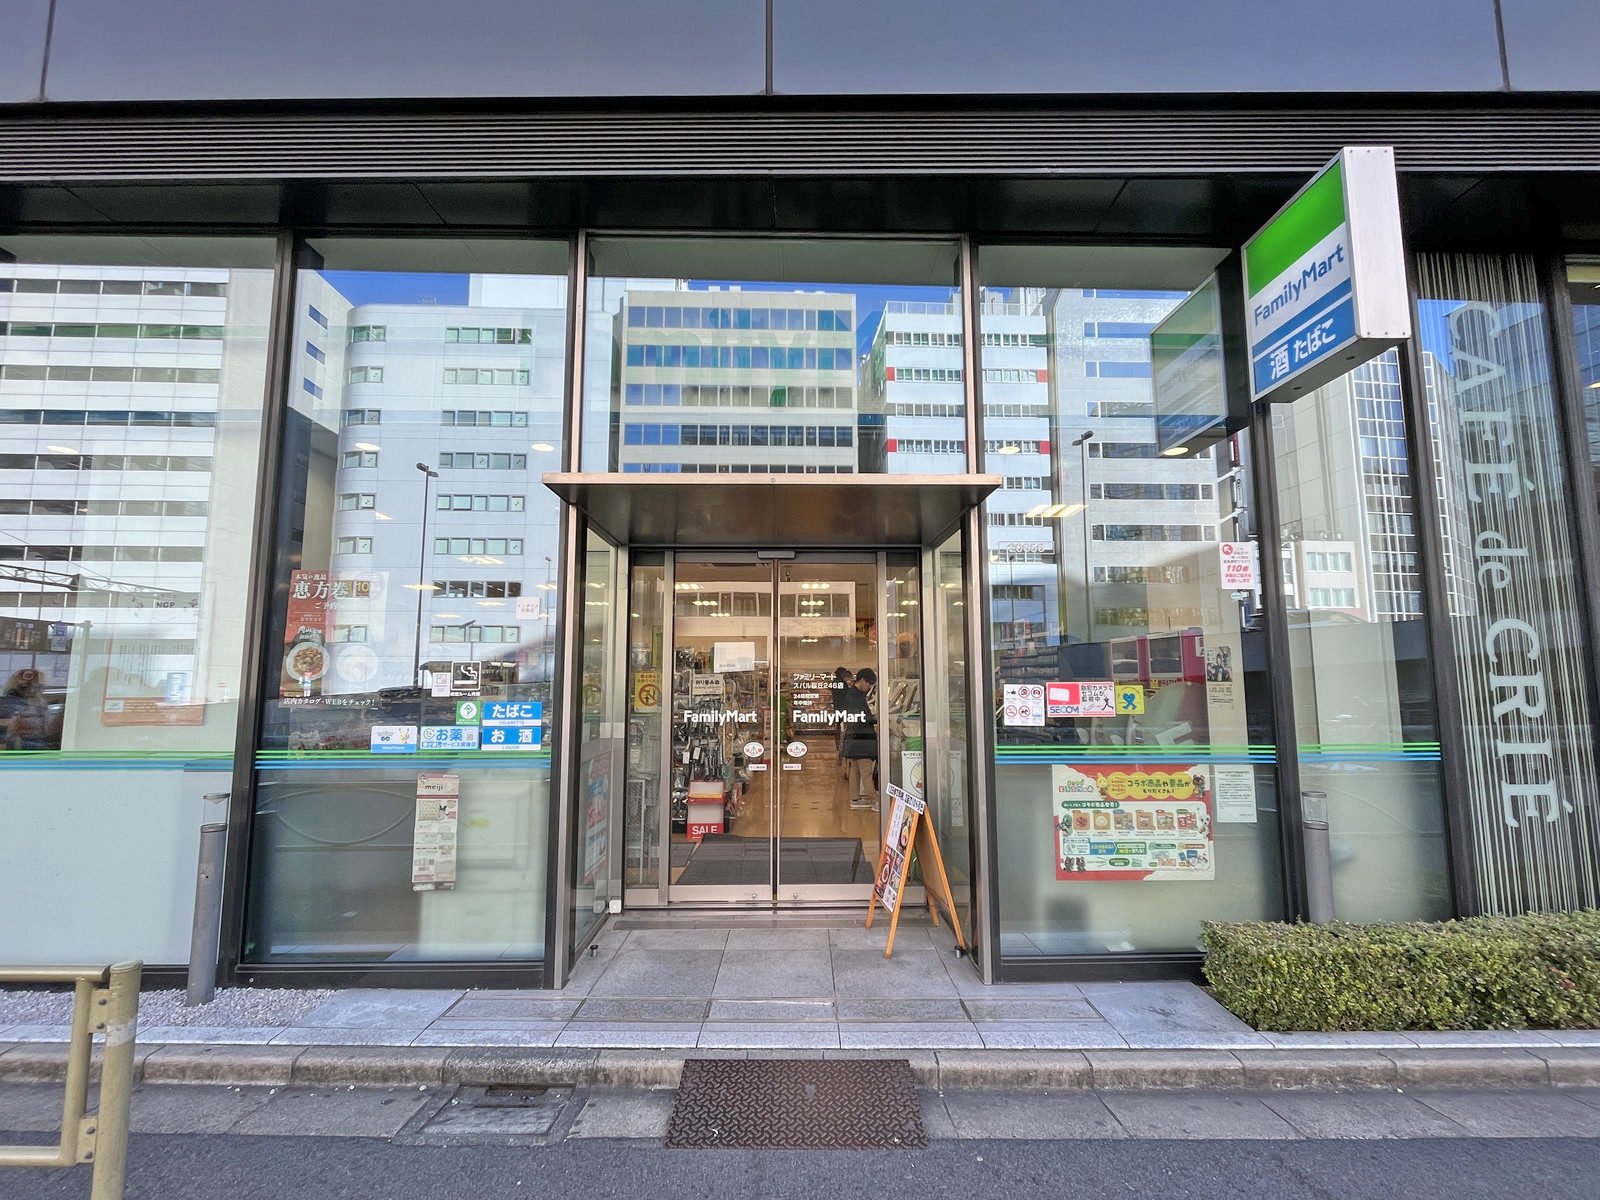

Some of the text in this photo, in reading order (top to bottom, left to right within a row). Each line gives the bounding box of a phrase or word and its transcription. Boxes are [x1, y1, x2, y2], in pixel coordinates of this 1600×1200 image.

[1253, 243, 1346, 327] FamilyMart
[1269, 317, 1337, 382] 酒 たばこ
[1450, 301, 1573, 829] CAFÉ de CRIÉ
[292, 580, 349, 599] 恵方巻
[492, 704, 533, 718] たばこ
[792, 709, 867, 726] FamilyMart
[1049, 705, 1080, 714] SECOM
[683, 710, 757, 726] FamilyMart
[436, 728, 463, 742] お薬
[424, 783, 444, 791] meiji
[692, 826, 718, 834] SALE
